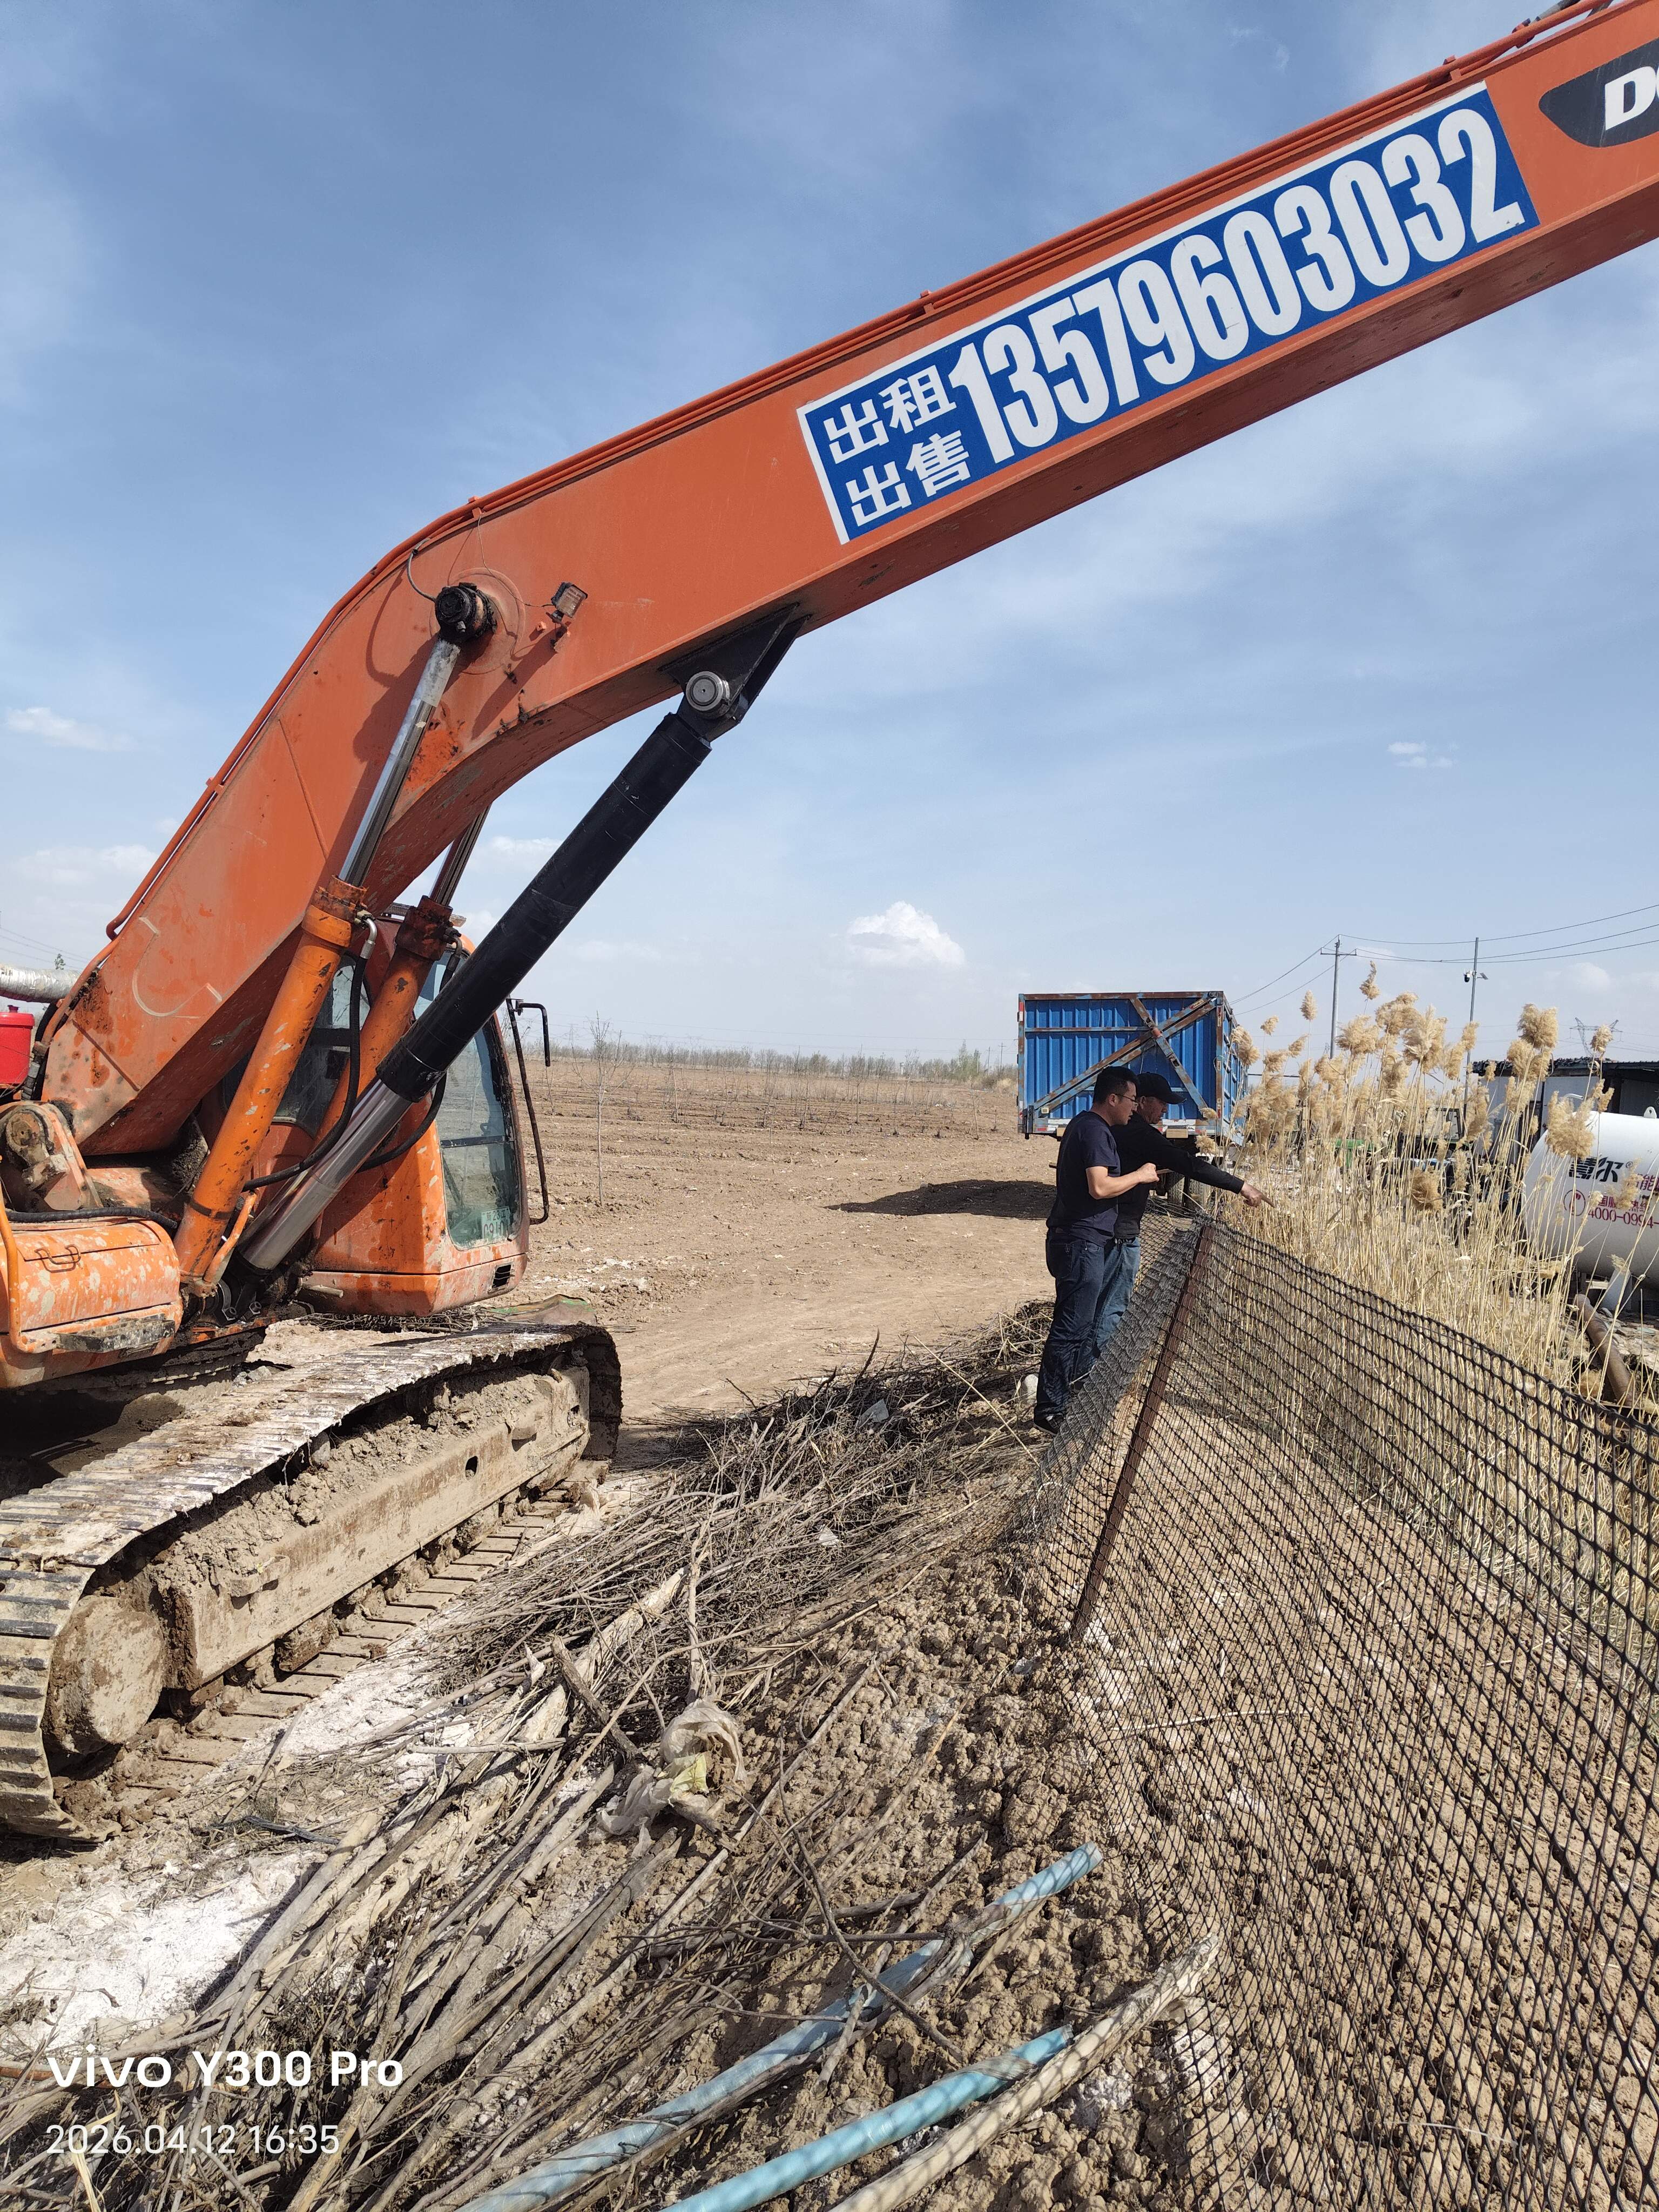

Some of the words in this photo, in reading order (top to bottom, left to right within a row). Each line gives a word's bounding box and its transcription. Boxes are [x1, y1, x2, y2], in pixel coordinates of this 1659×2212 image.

[1605, 66, 1658, 130] D
[948, 108, 1525, 463] 13579603032
[822, 364, 957, 464] 出租
[845, 429, 971, 527] 出售
